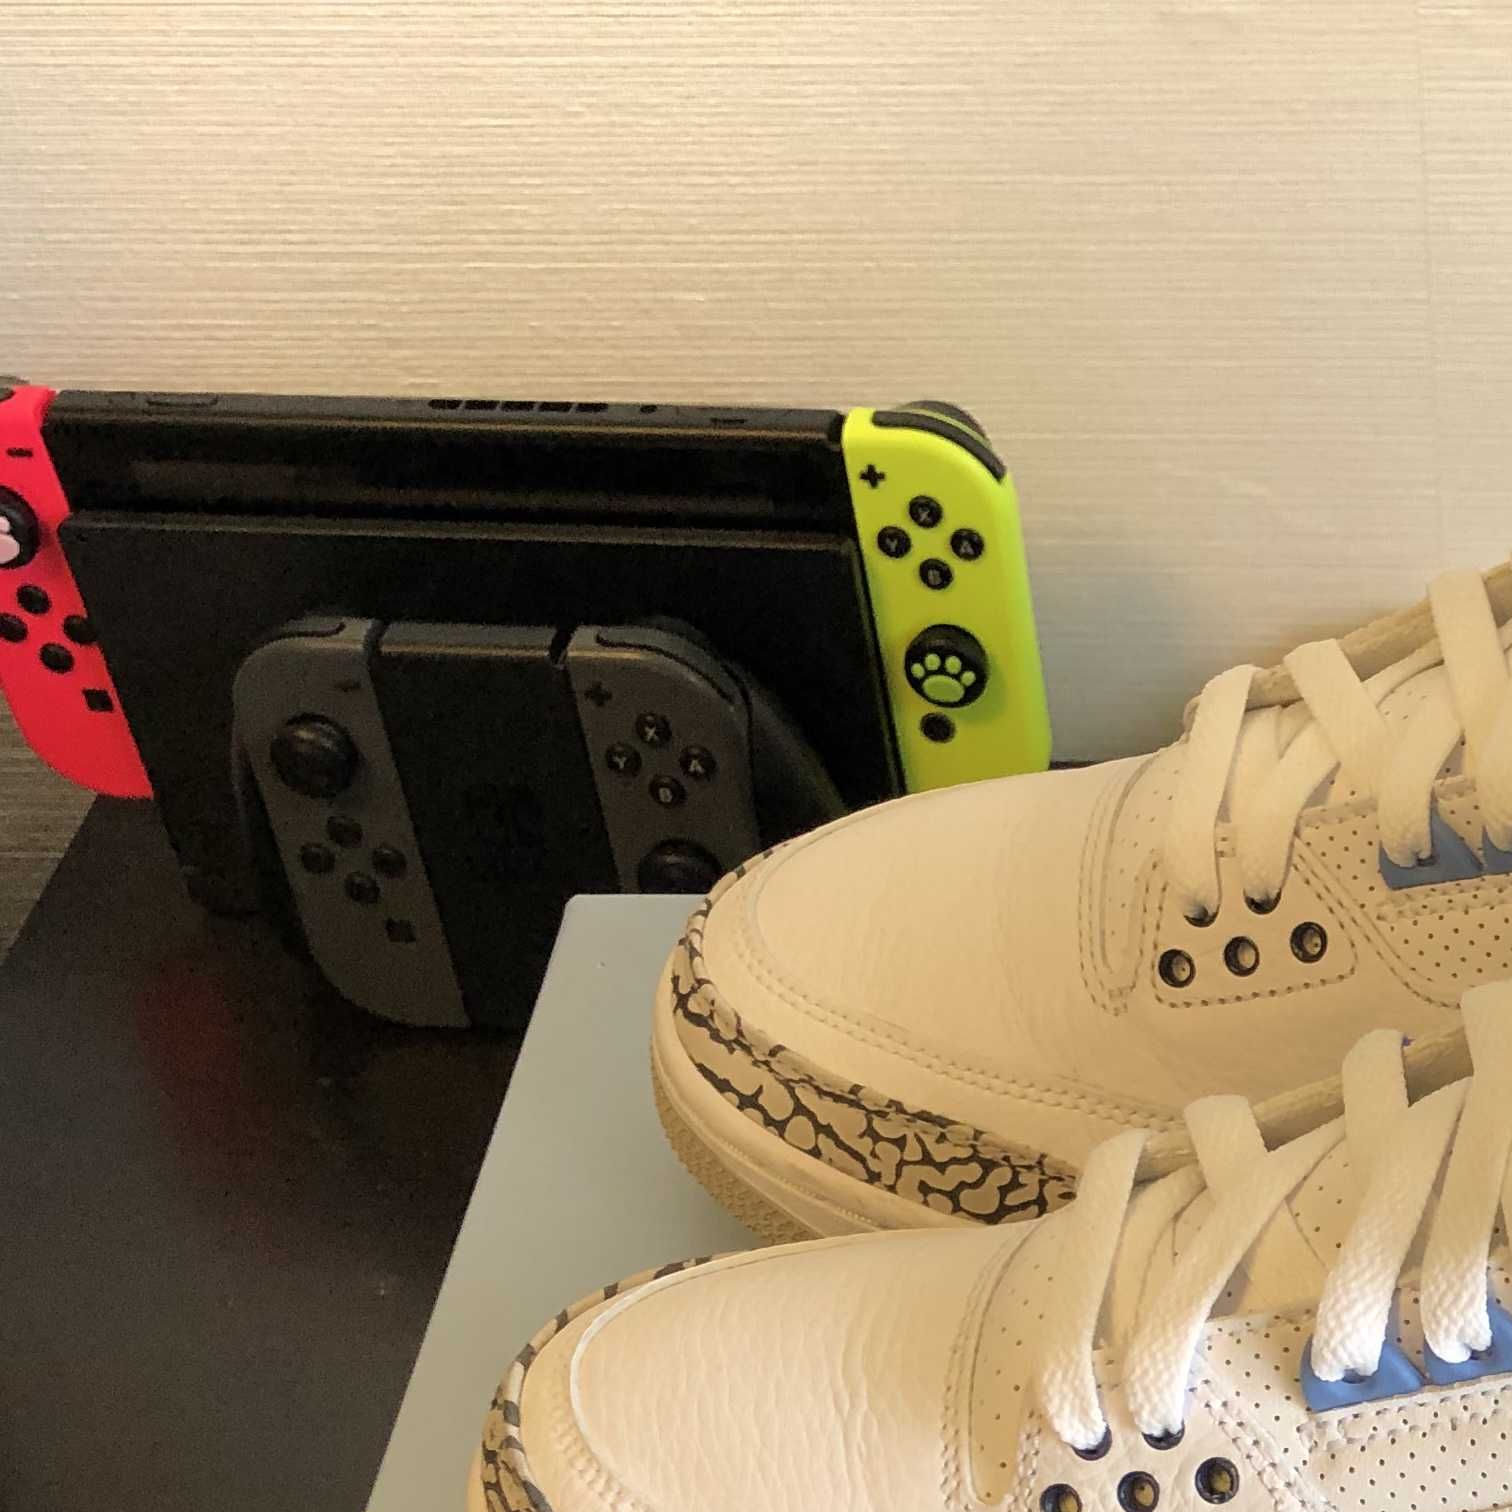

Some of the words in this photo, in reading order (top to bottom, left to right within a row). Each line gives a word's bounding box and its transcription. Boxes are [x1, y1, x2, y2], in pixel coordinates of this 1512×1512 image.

[643, 726, 659, 742] X
[612, 755, 627, 770] Y
[688, 759, 704, 774] A
